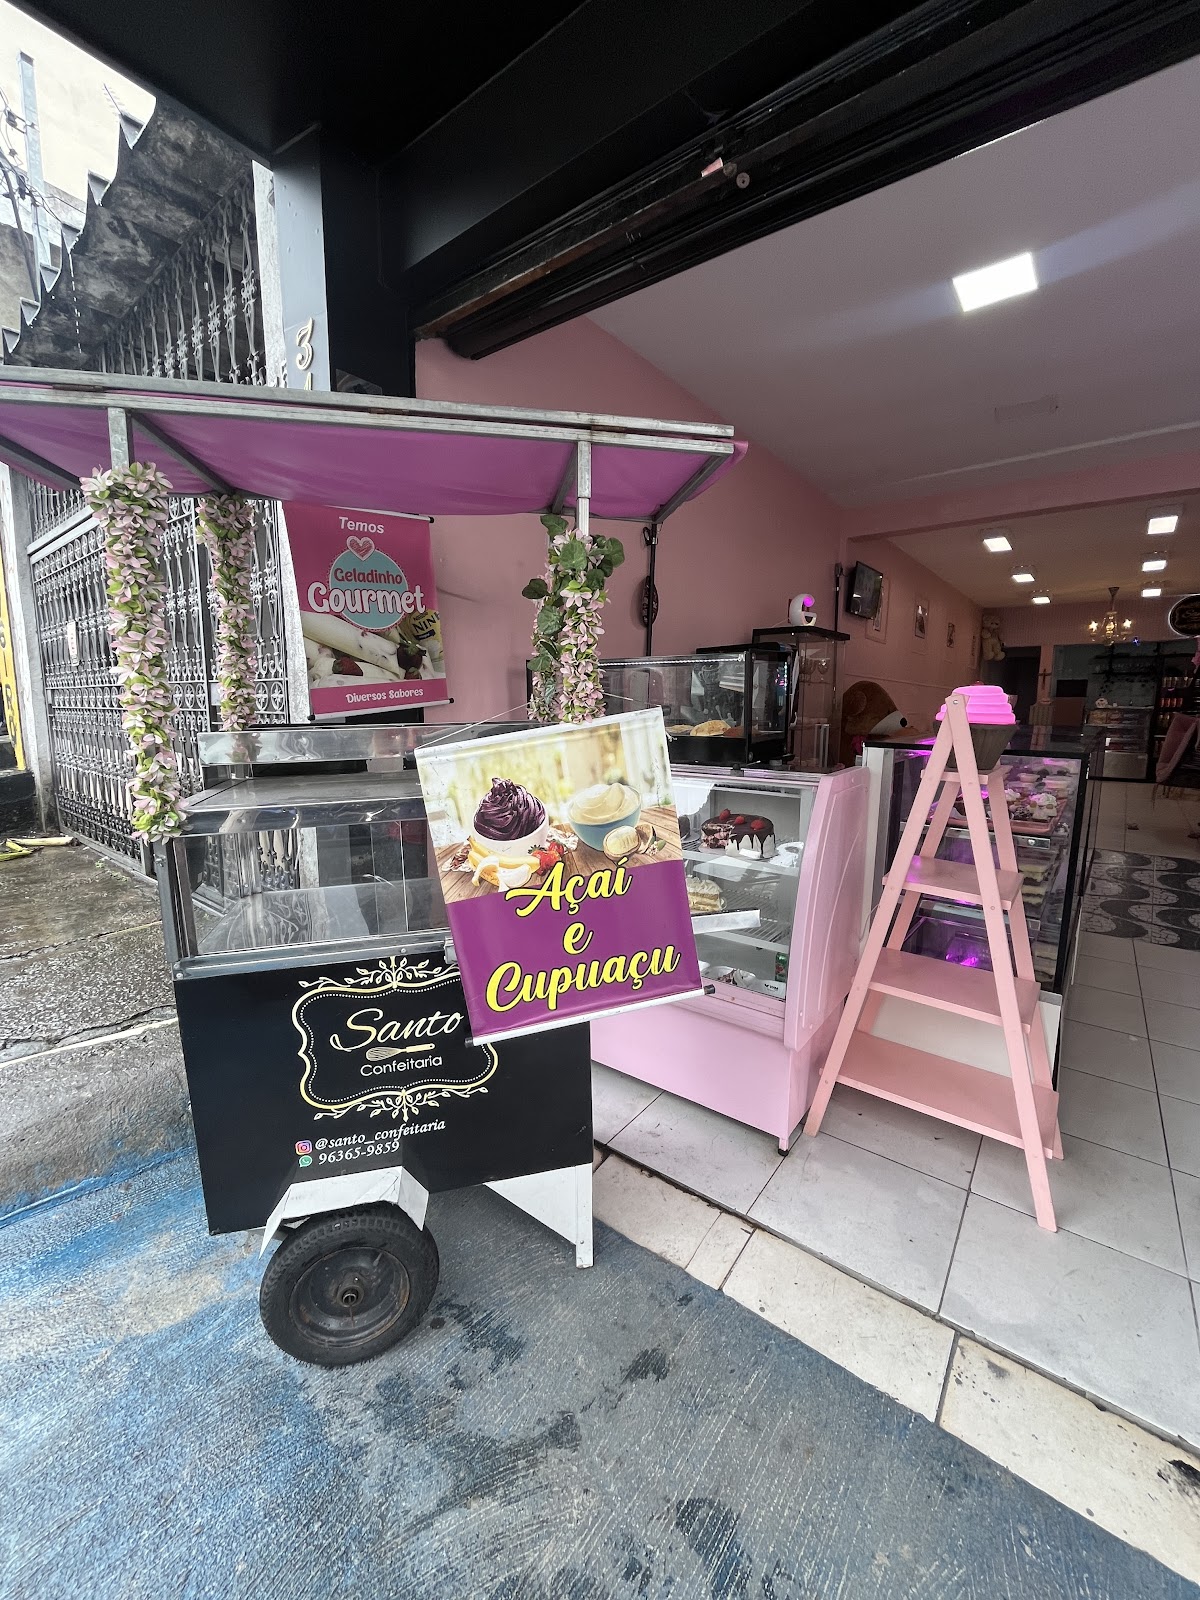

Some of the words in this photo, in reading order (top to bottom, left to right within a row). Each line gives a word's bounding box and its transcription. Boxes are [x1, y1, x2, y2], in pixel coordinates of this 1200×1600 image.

[338, 515, 385, 534] Temos
[333, 567, 403, 585] Geladinho
[307, 581, 427, 614] Gourmet
[345, 690, 387, 704] Diversos
[388, 687, 424, 699] Sabores
[505, 857, 633, 917] Açaí
[562, 920, 594, 956] e
[485, 945, 682, 1013] Cupuaçu
[330, 1008, 464, 1052] Santo
[360, 1055, 443, 1077] Confeitaria
[315, 1118, 446, 1151] @santo_confeitaria
[318, 1140, 400, 1165] 96365-9859
